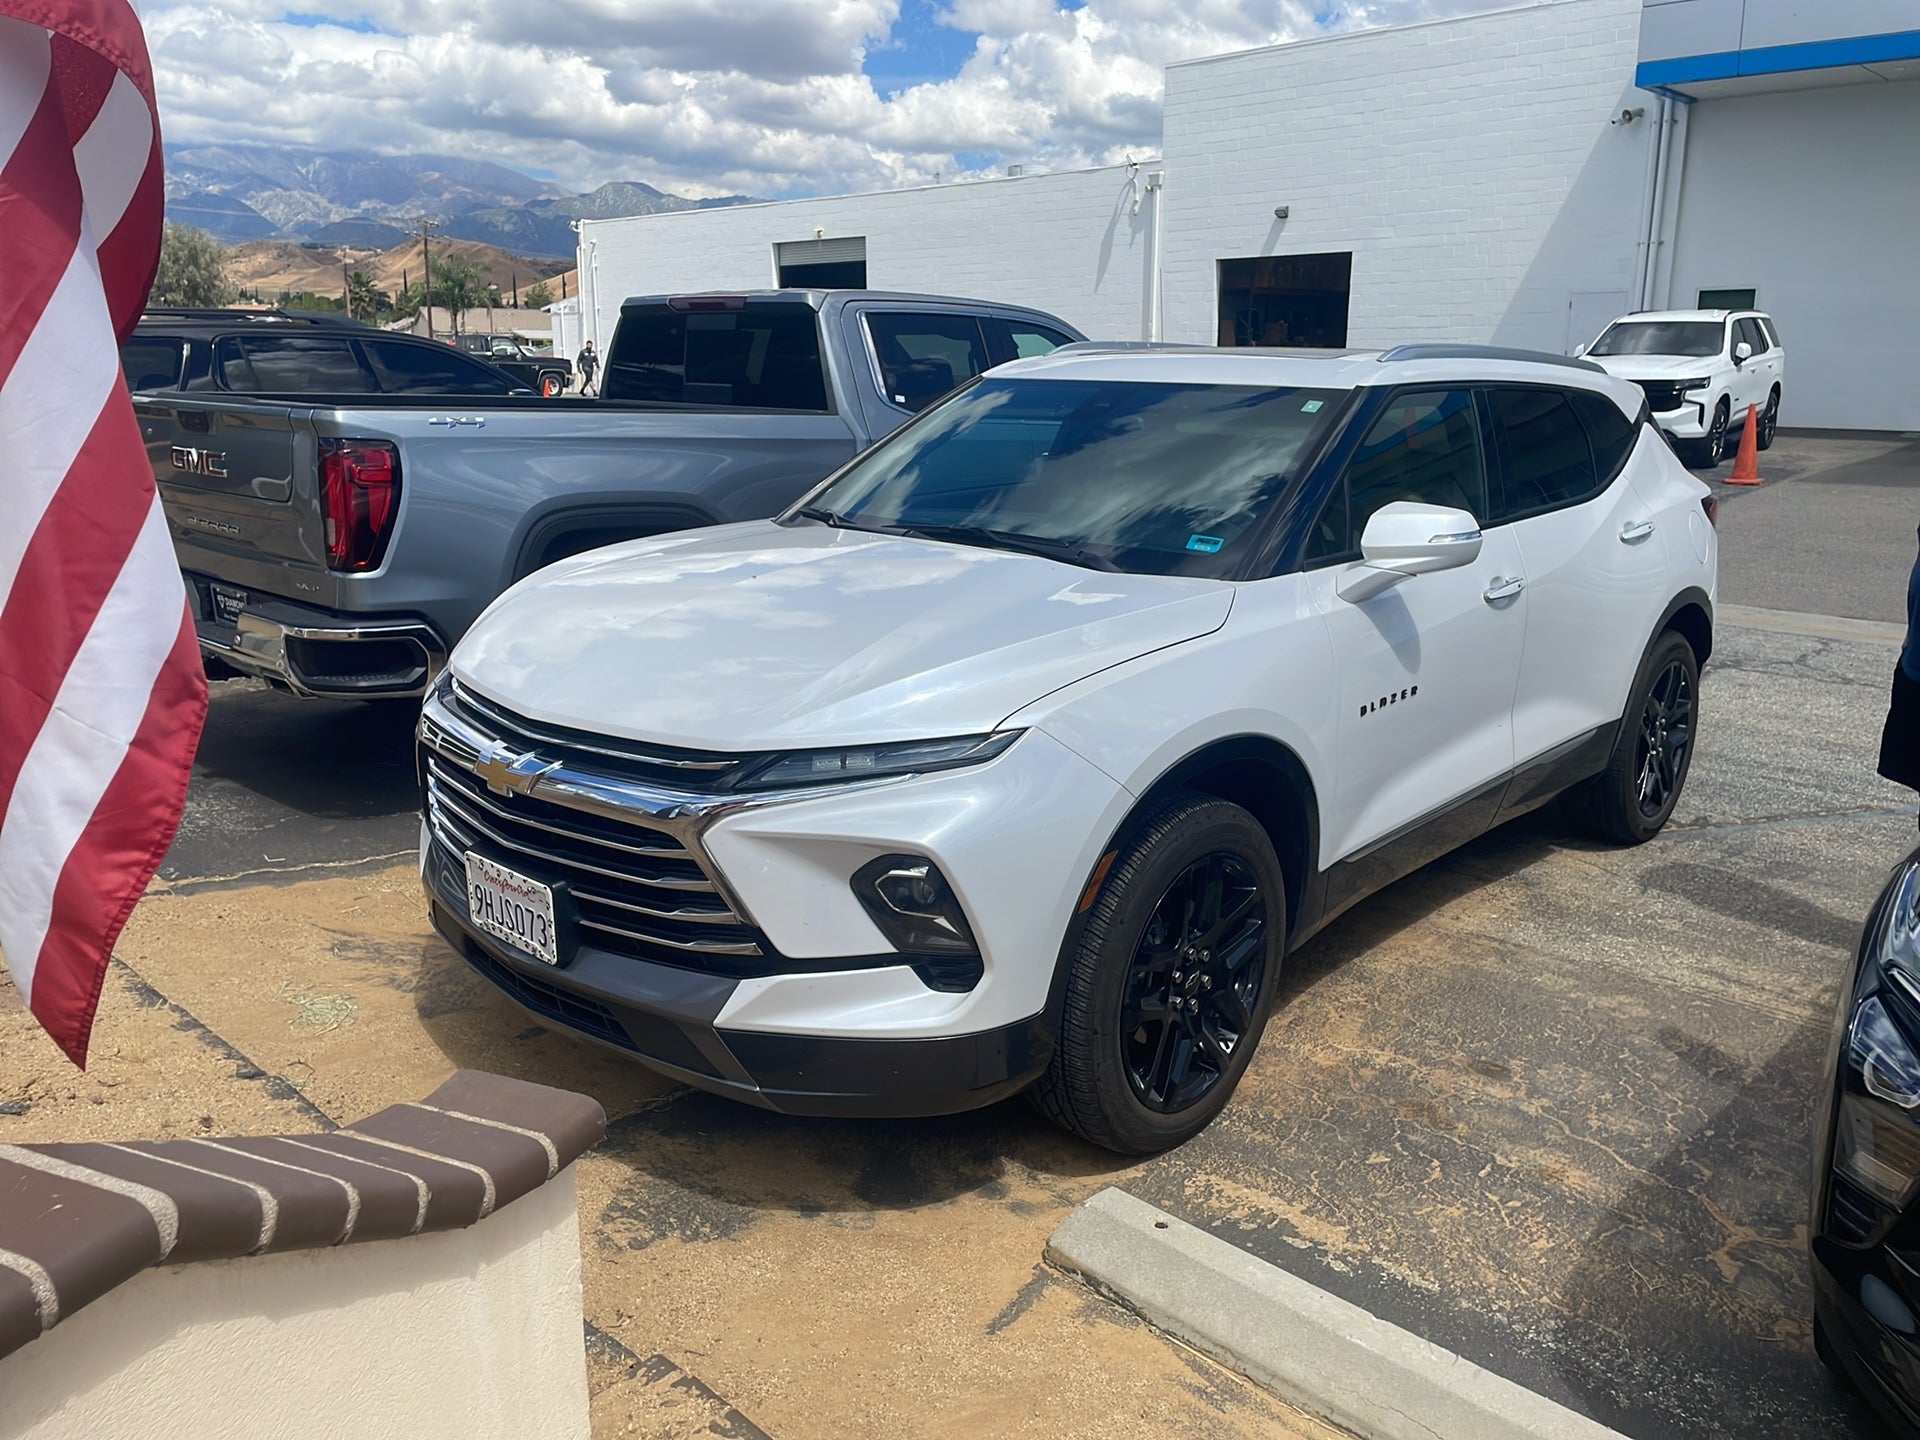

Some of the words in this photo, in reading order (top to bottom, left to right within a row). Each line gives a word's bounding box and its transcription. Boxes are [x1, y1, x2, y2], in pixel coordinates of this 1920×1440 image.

[171, 446, 228, 477] GMC
[1360, 685, 1418, 717] BLAZER
[474, 883, 548, 948] 9HJS073
